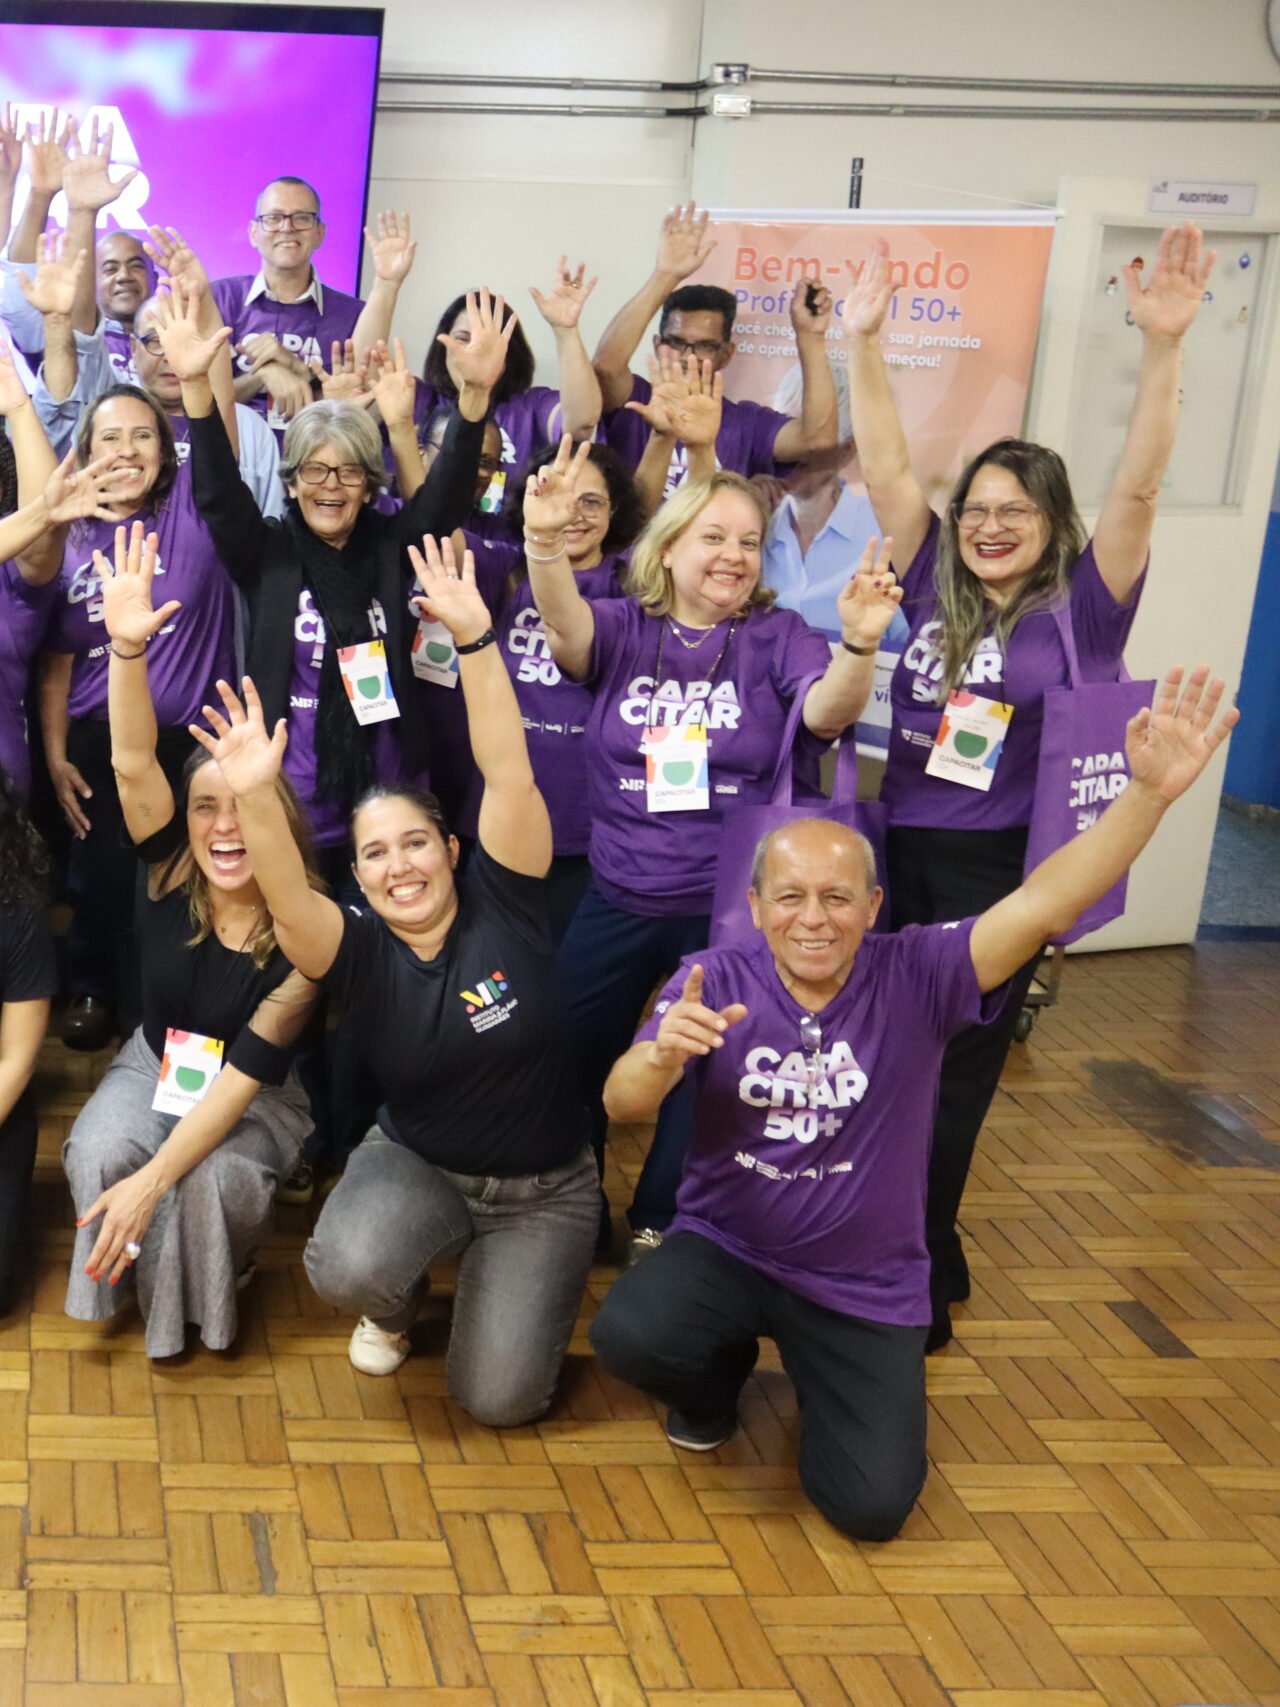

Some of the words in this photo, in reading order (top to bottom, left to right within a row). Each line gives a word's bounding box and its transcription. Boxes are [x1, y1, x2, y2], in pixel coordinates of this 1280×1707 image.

[734, 247, 971, 291] Bem-vndo
[910, 297, 962, 322] 50+
[737, 342, 755, 356] de
[764, 323, 796, 341] cheg
[888, 331, 916, 345] sua
[917, 331, 982, 350] jornada
[627, 676, 739, 704] CAPA
[619, 697, 742, 729] CITAR
[738, 1073, 869, 1111] CITAR
[763, 1108, 843, 1143] 50+
